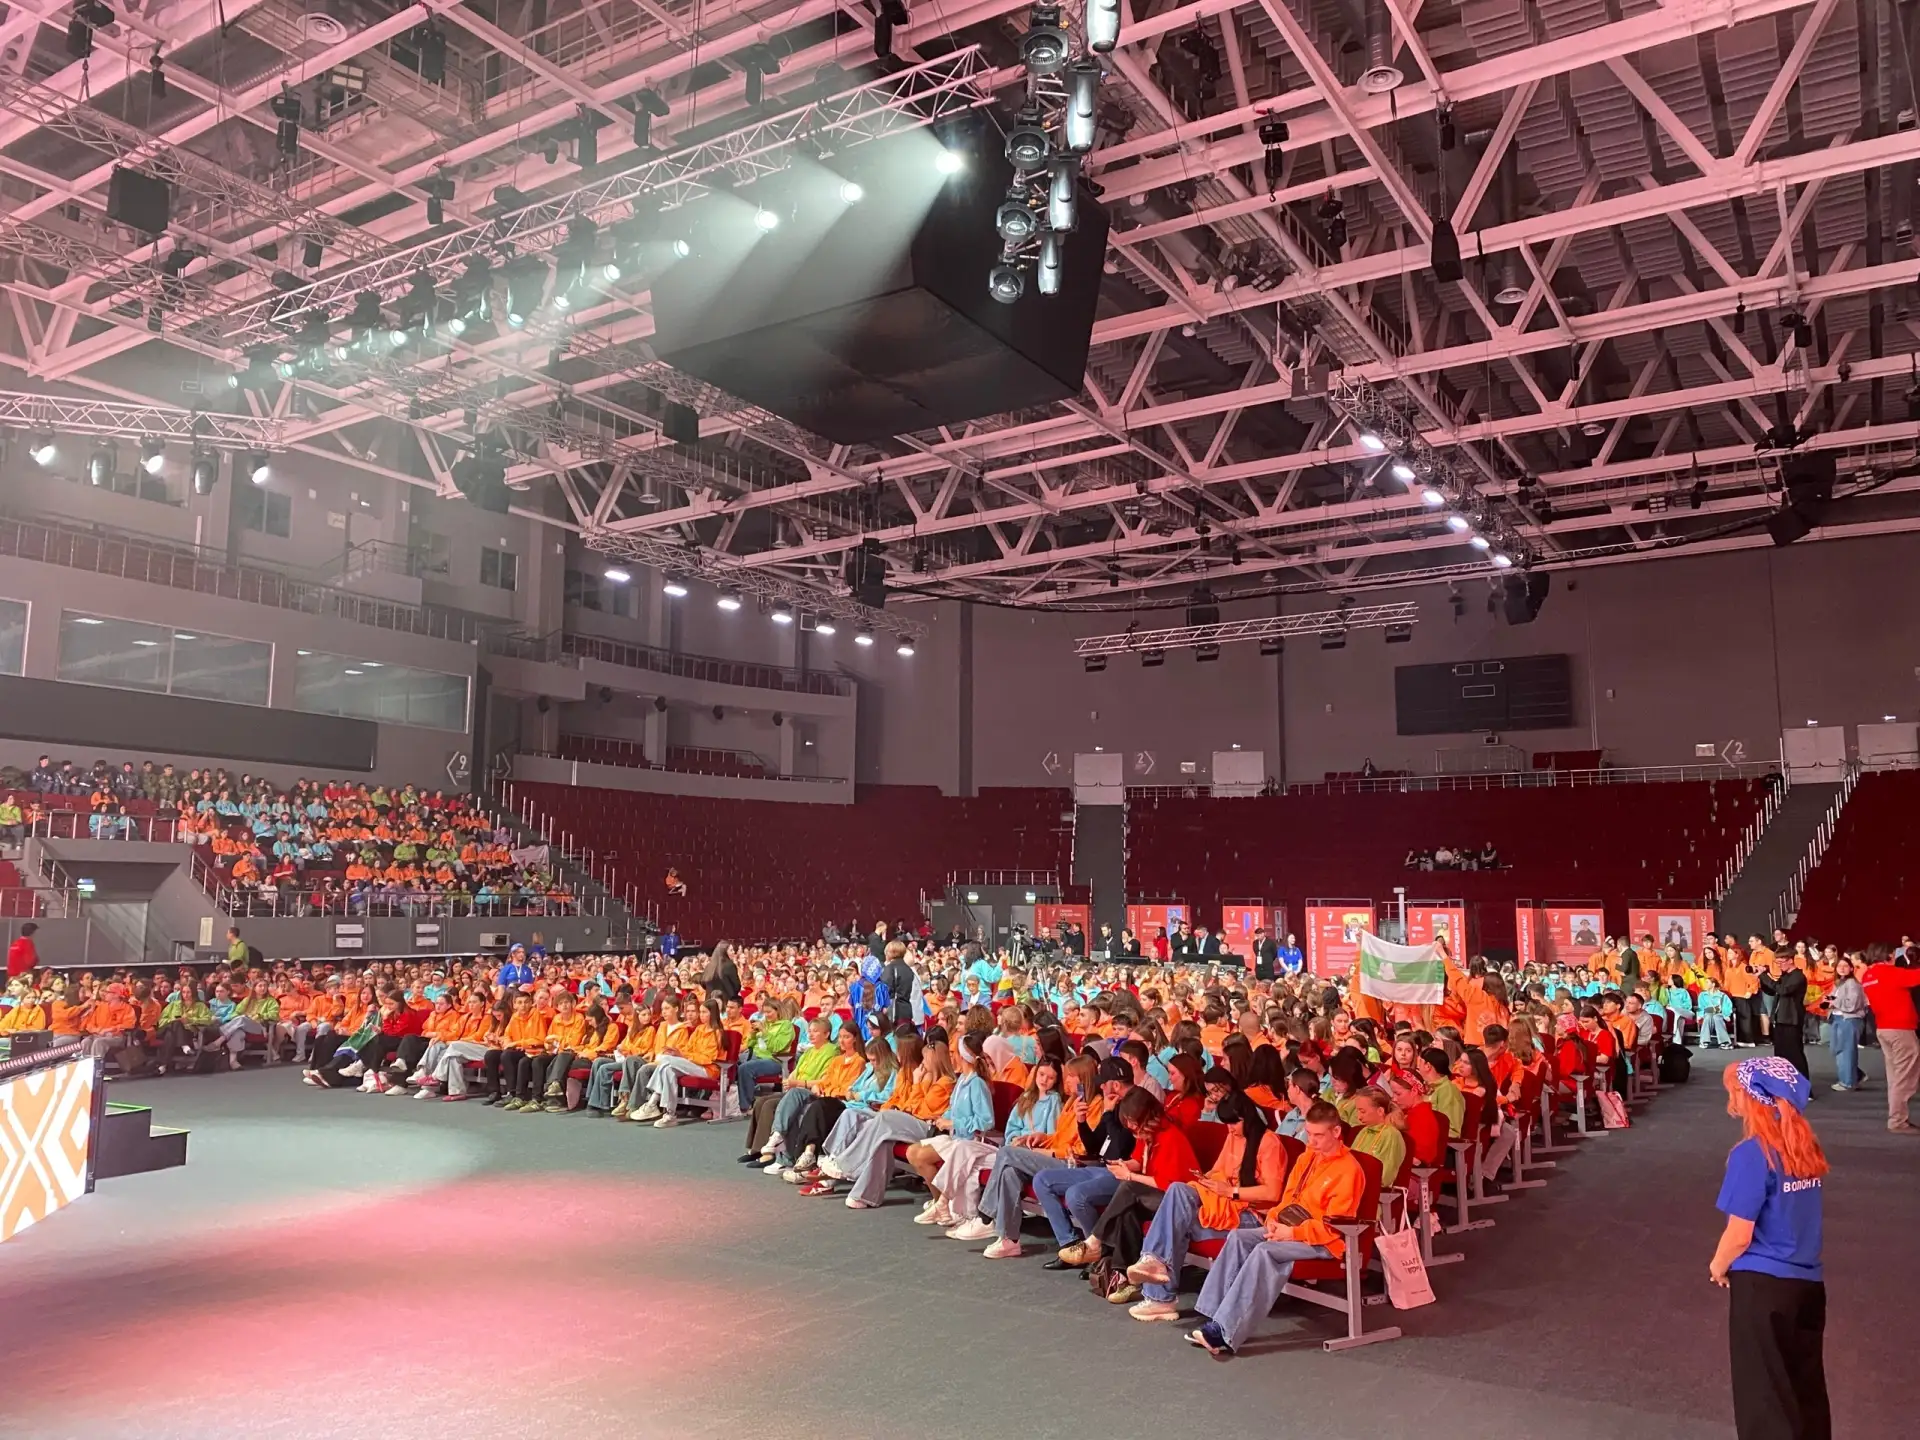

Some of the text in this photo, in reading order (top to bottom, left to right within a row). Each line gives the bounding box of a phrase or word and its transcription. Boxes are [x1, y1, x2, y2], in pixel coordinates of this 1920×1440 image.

[1734, 742, 1744, 755] 2
[459, 755, 467, 770] 9
[1053, 754, 1059, 764] 1
[1137, 753, 1144, 764] 2
